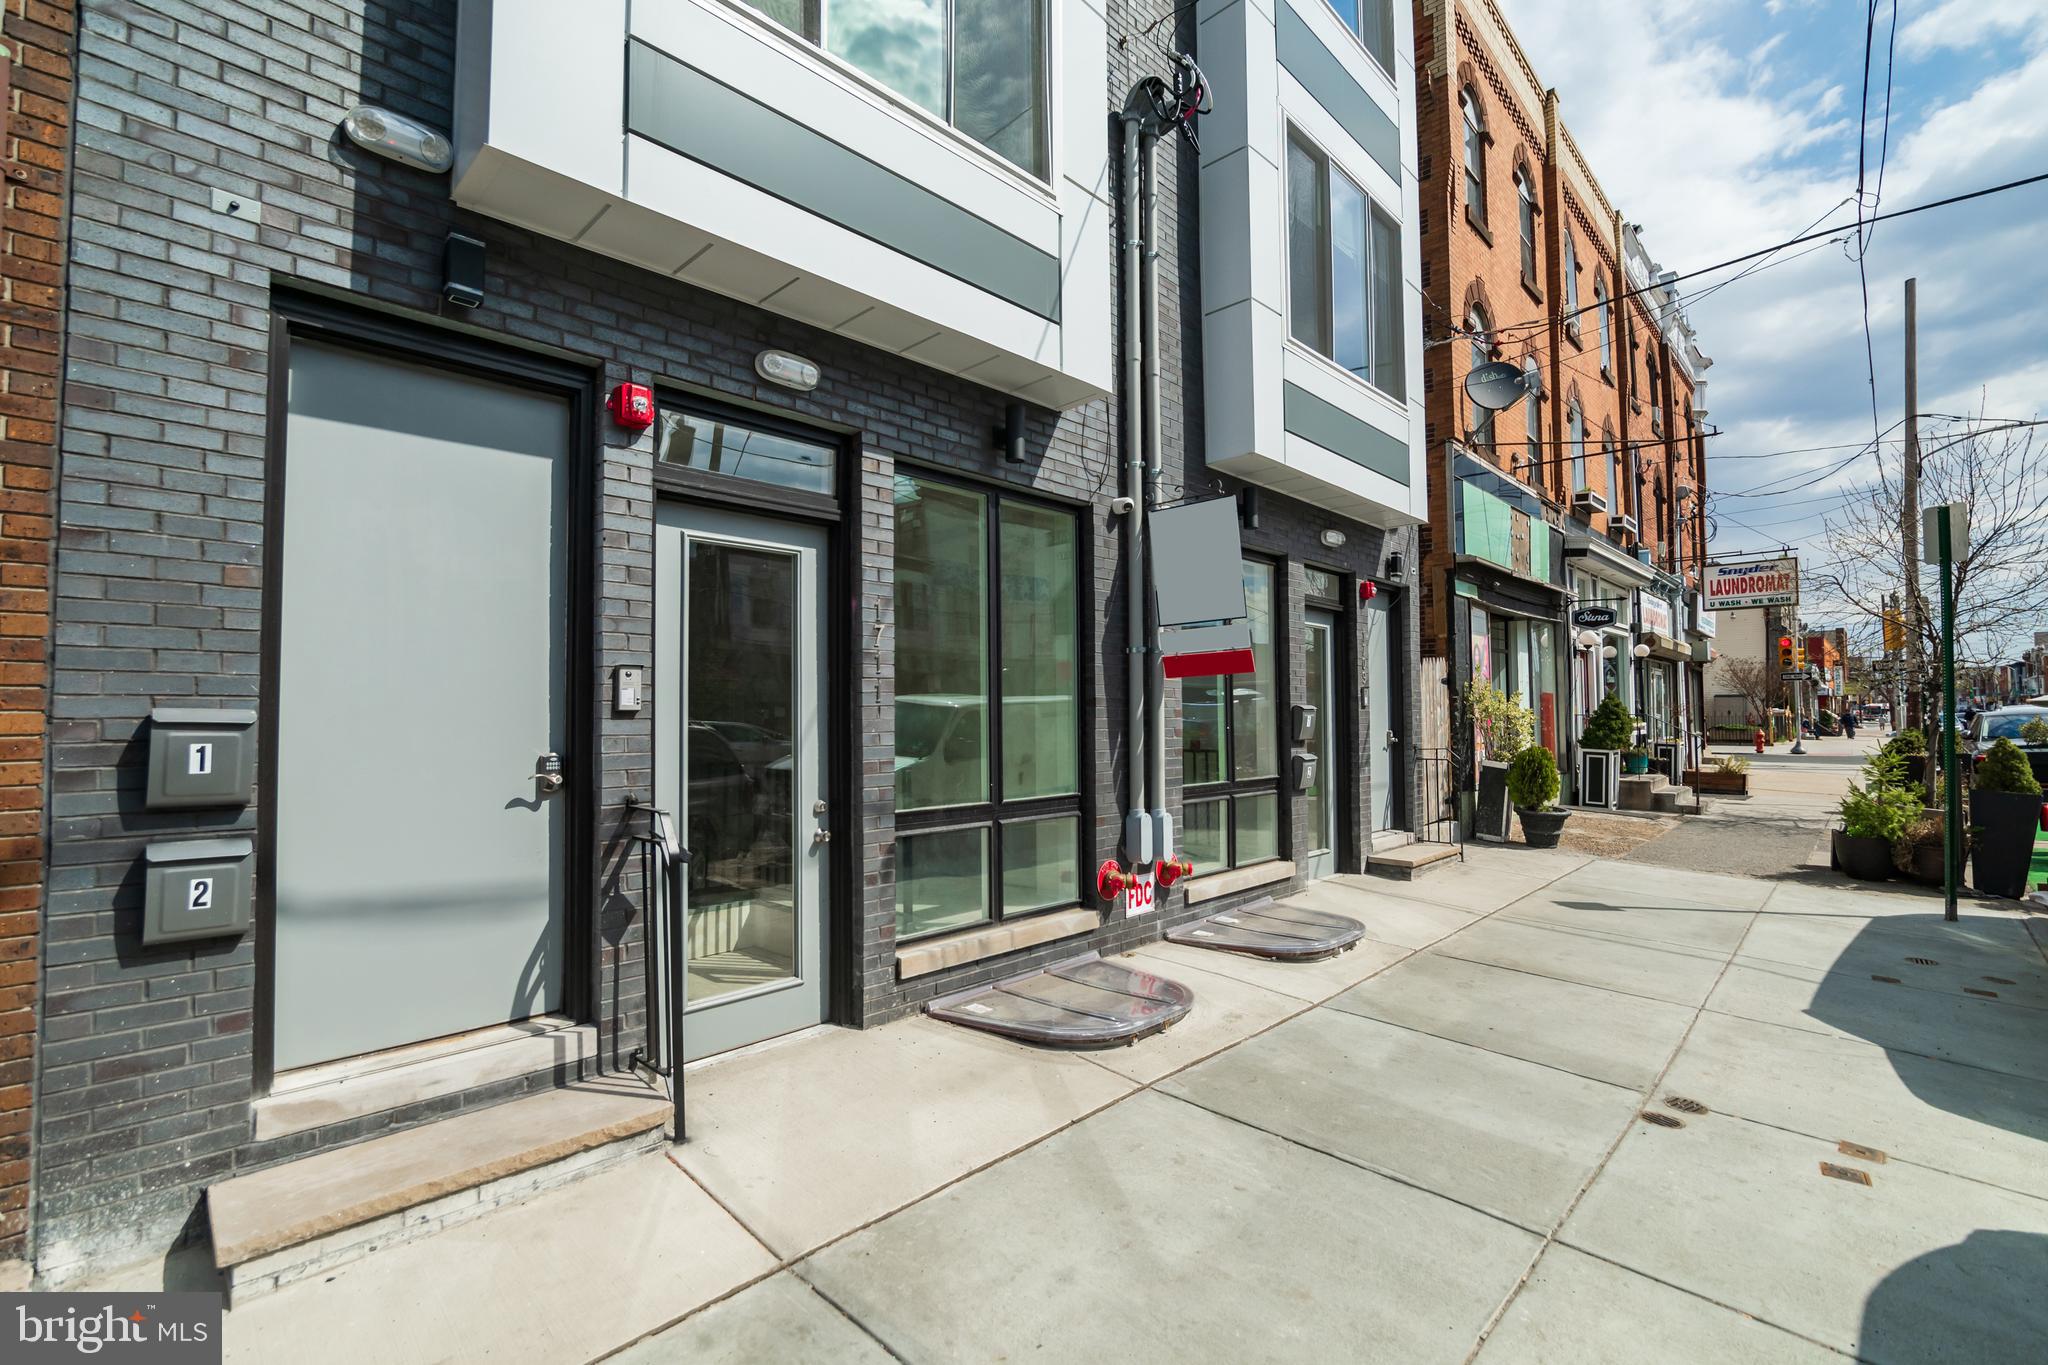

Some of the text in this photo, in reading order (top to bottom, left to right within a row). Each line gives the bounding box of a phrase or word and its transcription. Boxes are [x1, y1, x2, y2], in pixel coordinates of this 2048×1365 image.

[1717, 564, 1779, 576] Snyder
[1709, 573, 1791, 597] LAUNDROMAT
[1718, 599, 1742, 607] WASH
[1751, 597, 1764, 605] WE
[1767, 595, 1792, 604] WASH
[195, 744, 206, 773] 1
[192, 880, 209, 908] 2
[1128, 881, 1152, 910] FDC
